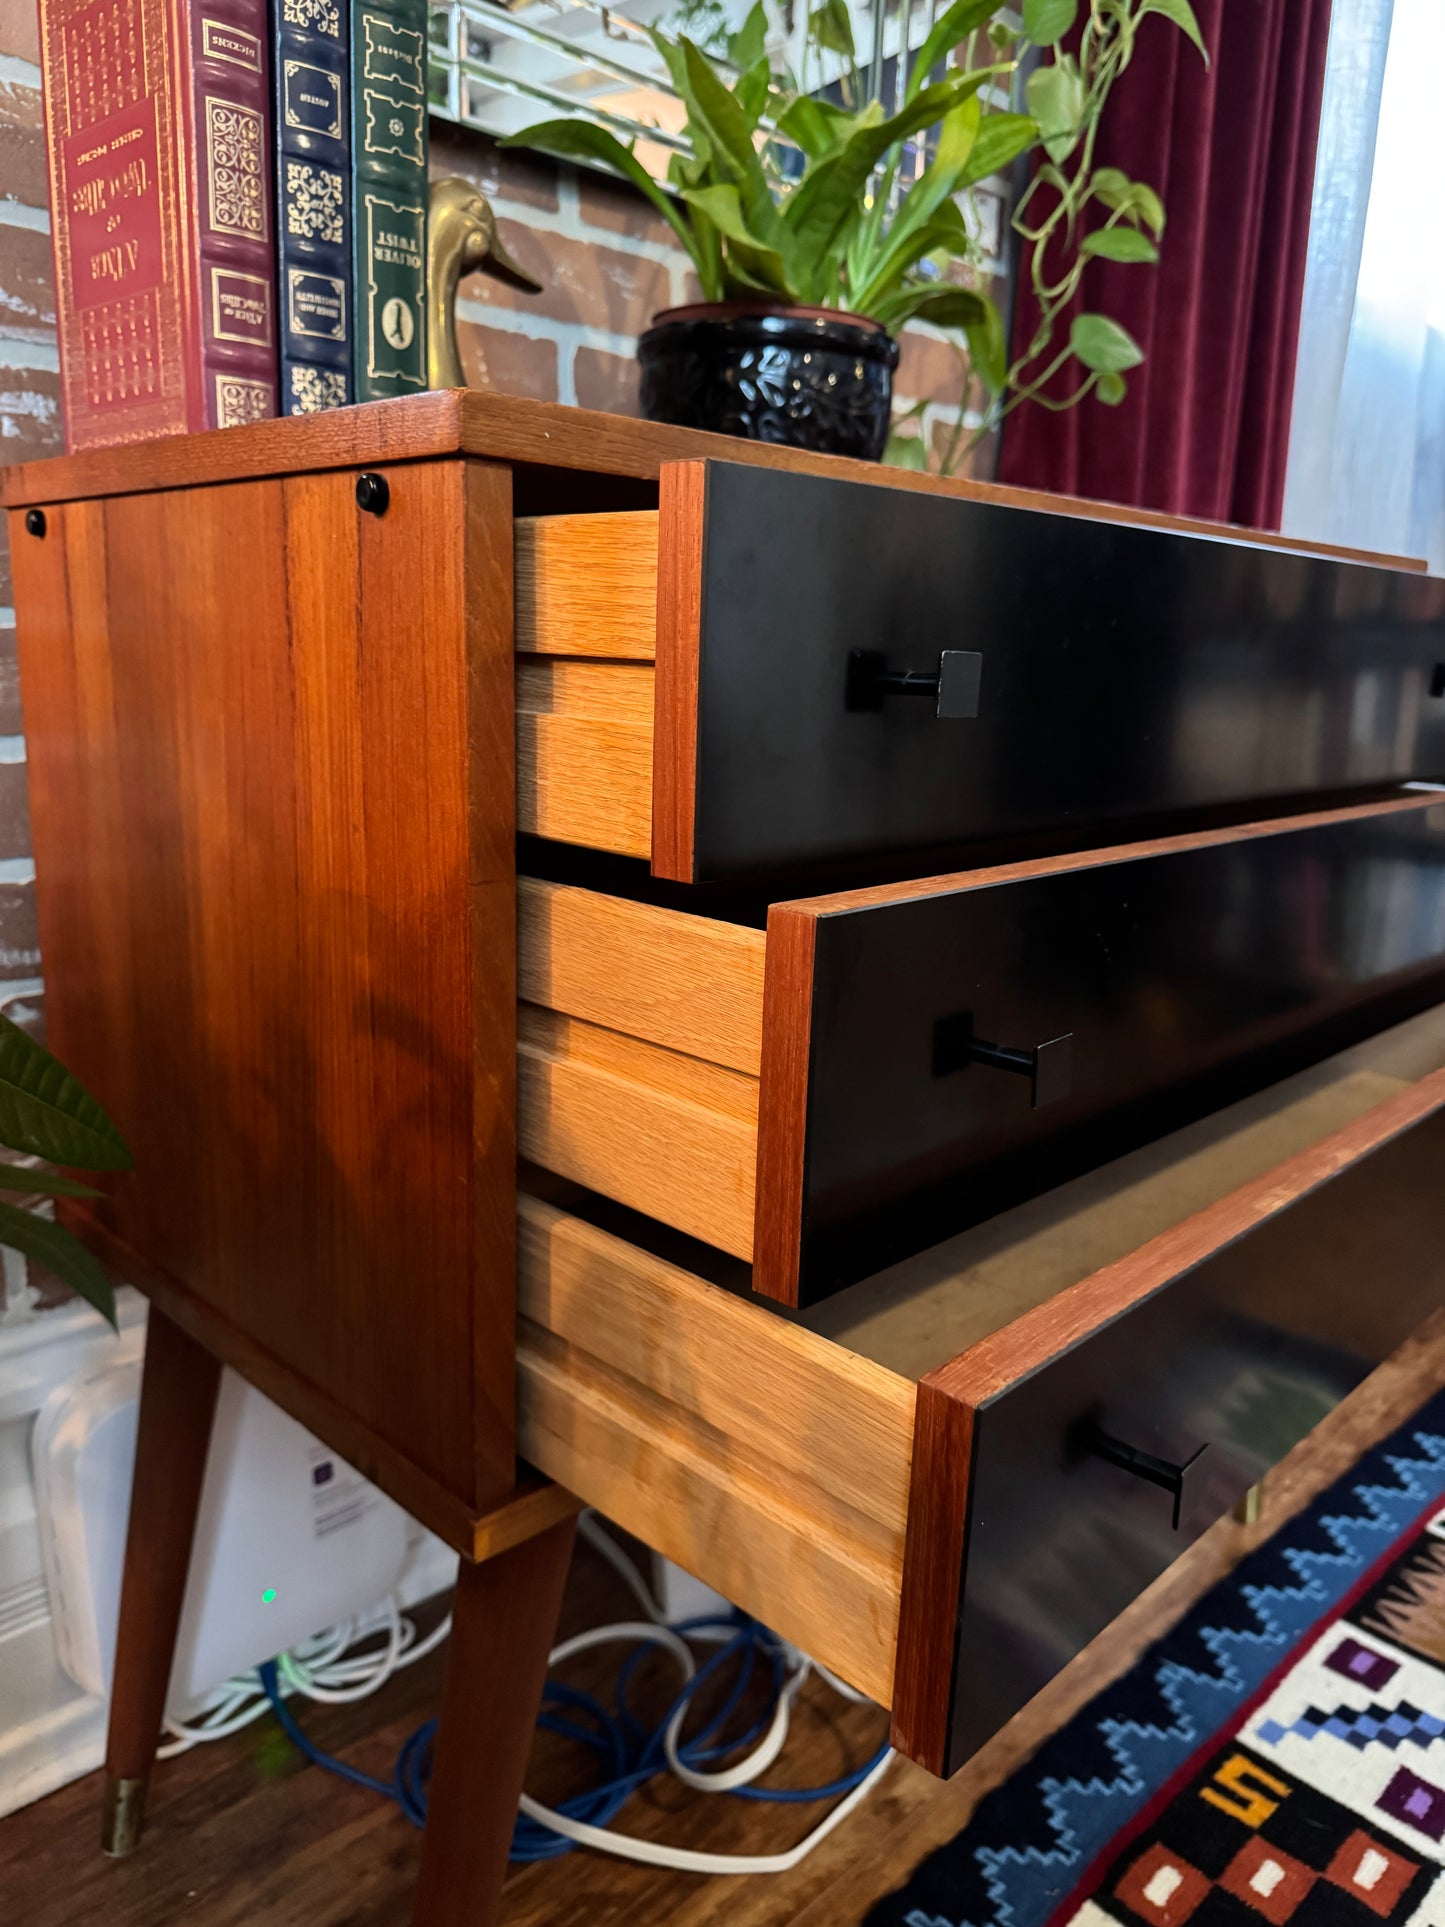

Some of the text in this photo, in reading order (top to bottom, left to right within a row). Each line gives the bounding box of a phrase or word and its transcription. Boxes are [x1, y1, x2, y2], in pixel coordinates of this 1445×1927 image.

[212, 36, 256, 58] DICKENS
[376, 230, 419, 253] TWIST
[373, 246, 422, 269] OLIVER
